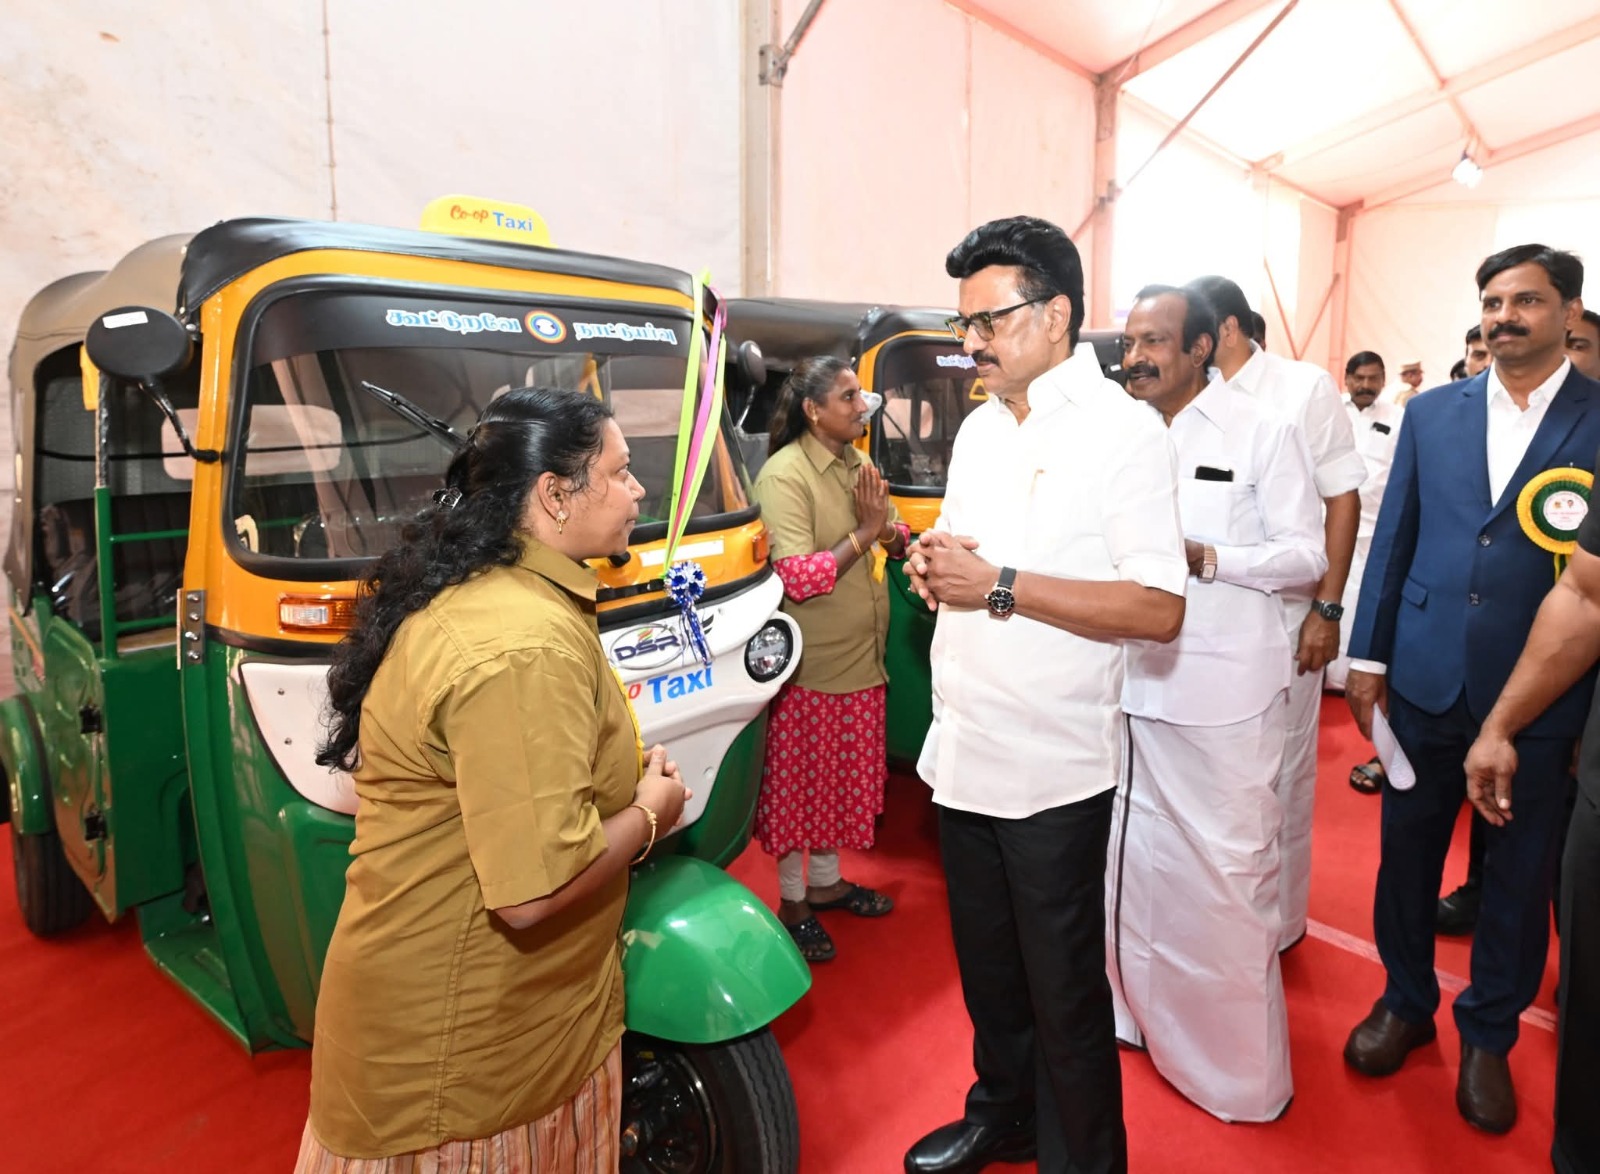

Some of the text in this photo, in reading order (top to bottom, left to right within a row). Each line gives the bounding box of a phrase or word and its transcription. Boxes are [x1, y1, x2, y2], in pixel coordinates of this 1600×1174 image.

[450, 204, 532, 231] Co-op Taxi
[614, 635, 680, 661] DSR
[647, 662, 713, 704] Taxi
